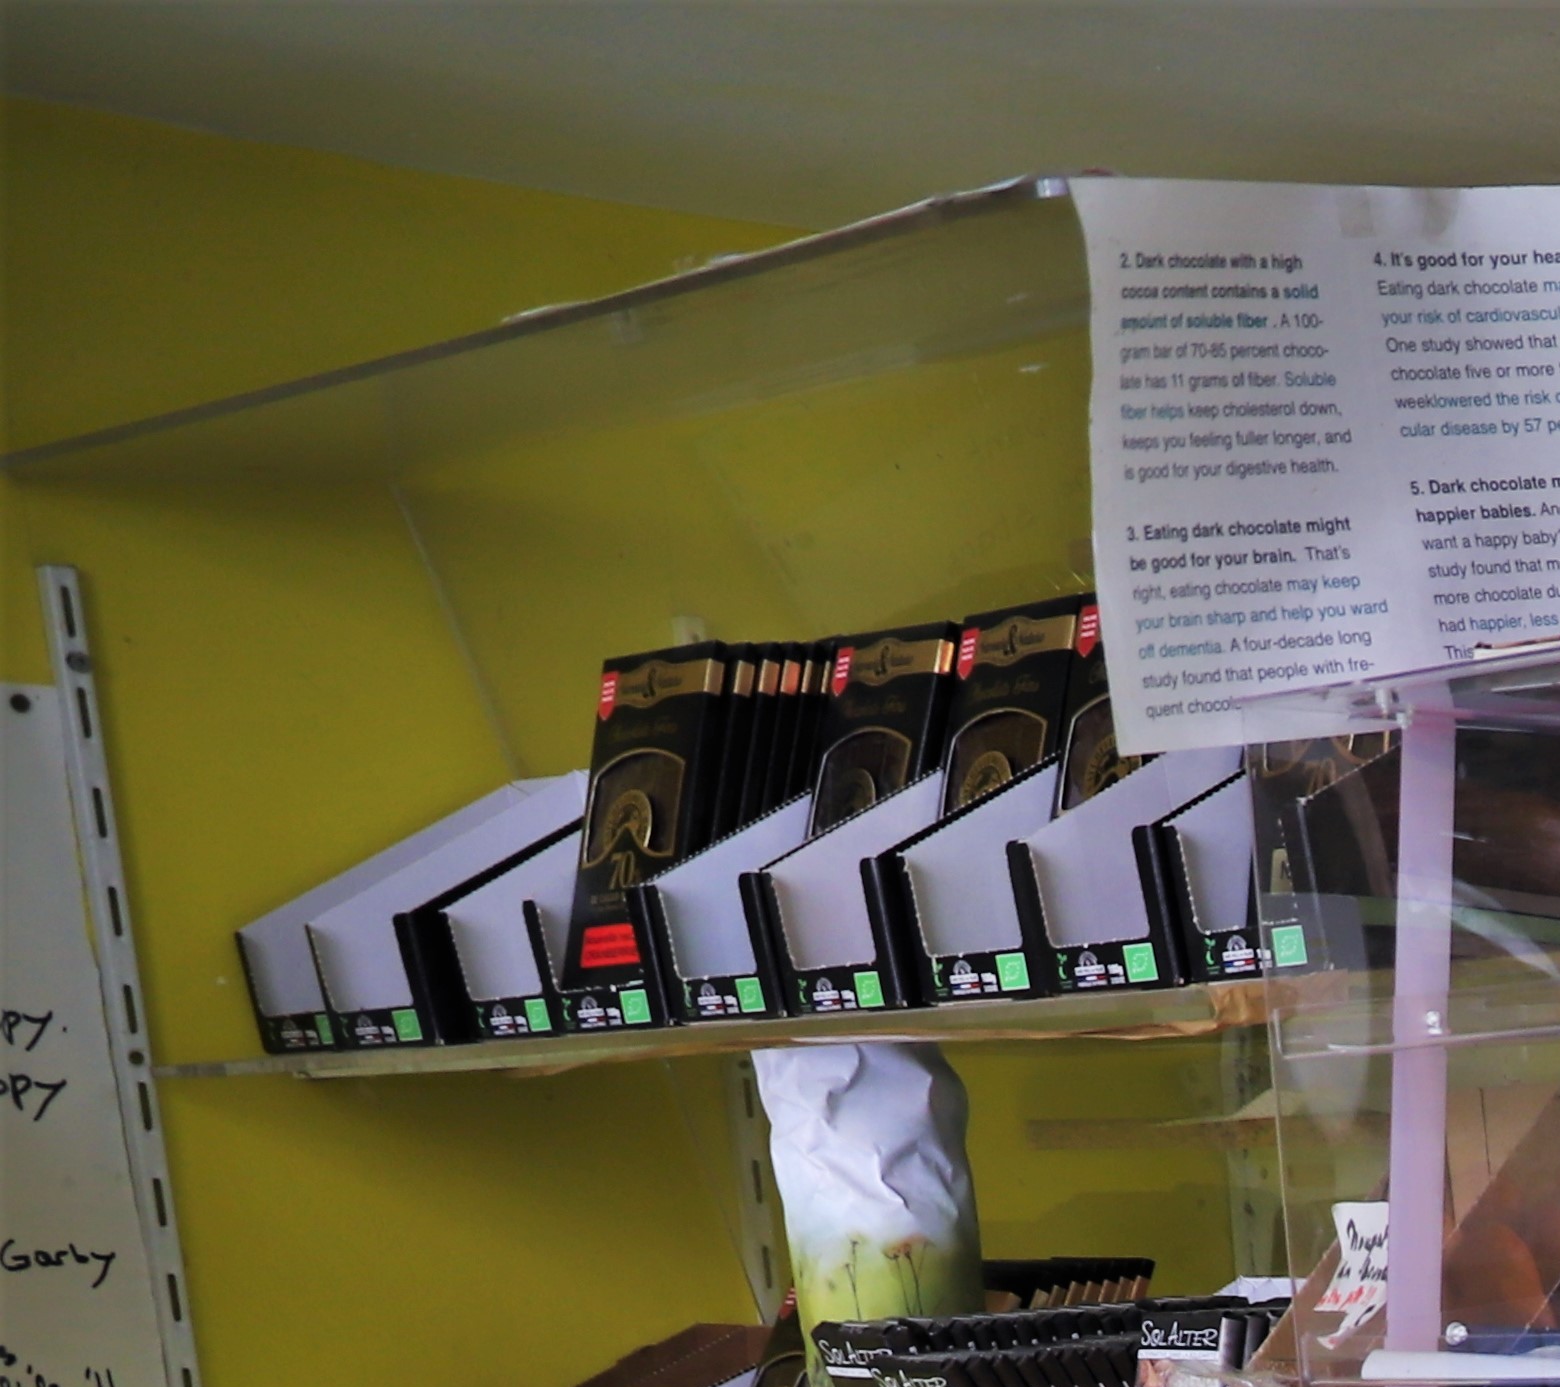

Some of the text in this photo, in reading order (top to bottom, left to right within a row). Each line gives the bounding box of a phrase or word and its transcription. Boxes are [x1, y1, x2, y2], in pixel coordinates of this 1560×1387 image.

[1374, 252, 1387, 266] 4.
[1390, 252, 1412, 267] It's
[1417, 252, 1457, 271] good
[1461, 252, 1483, 266] for
[1377, 280, 1422, 300] Eating
[1426, 281, 1459, 296] dark
[1463, 279, 1537, 295] chocolate
[1417, 310, 1443, 324] risk
[1447, 309, 1461, 324] of
[1385, 337, 1416, 353] One
[1421, 337, 1459, 355] study
[1465, 335, 1523, 351] showed
[1527, 335, 1556, 349] that
[1390, 366, 1460, 381] chocolate
[1464, 364, 1491, 379] five
[1496, 367, 1510, 378] or
[1515, 365, 1554, 377] more
[1495, 392, 1519, 406] the
[1524, 390, 1550, 404] risk
[1400, 423, 1434, 437] cular
[1440, 421, 1497, 436] disease
[1501, 420, 1518, 437] by
[1523, 418, 1541, 432] 57
[1410, 481, 1426, 495] 5.
[1428, 479, 1465, 494] Dark
[1470, 476, 1546, 492] chocolate
[1415, 507, 1474, 525] happier
[1479, 504, 1535, 519] babies.
[1127, 517, 1350, 543] 3. Eating dark chocolate might
[1422, 535, 1457, 550] want
[1462, 537, 1471, 548] a
[1474, 532, 1517, 550] happy
[1129, 557, 1146, 571] be
[1151, 554, 1186, 574] good
[1190, 552, 1210, 567] for
[1252, 548, 1295, 564] brain.
[1304, 545, 1349, 561] That's
[1428, 562, 1466, 579] study
[1471, 560, 1510, 575] found
[1514, 559, 1542, 572] that
[1433, 593, 1469, 604] more
[1474, 586, 1541, 603] chocolate
[1438, 618, 1465, 632] had
[1469, 614, 1526, 633] happier,
[1529, 612, 1558, 627] less
[1443, 641, 1474, 659] This
